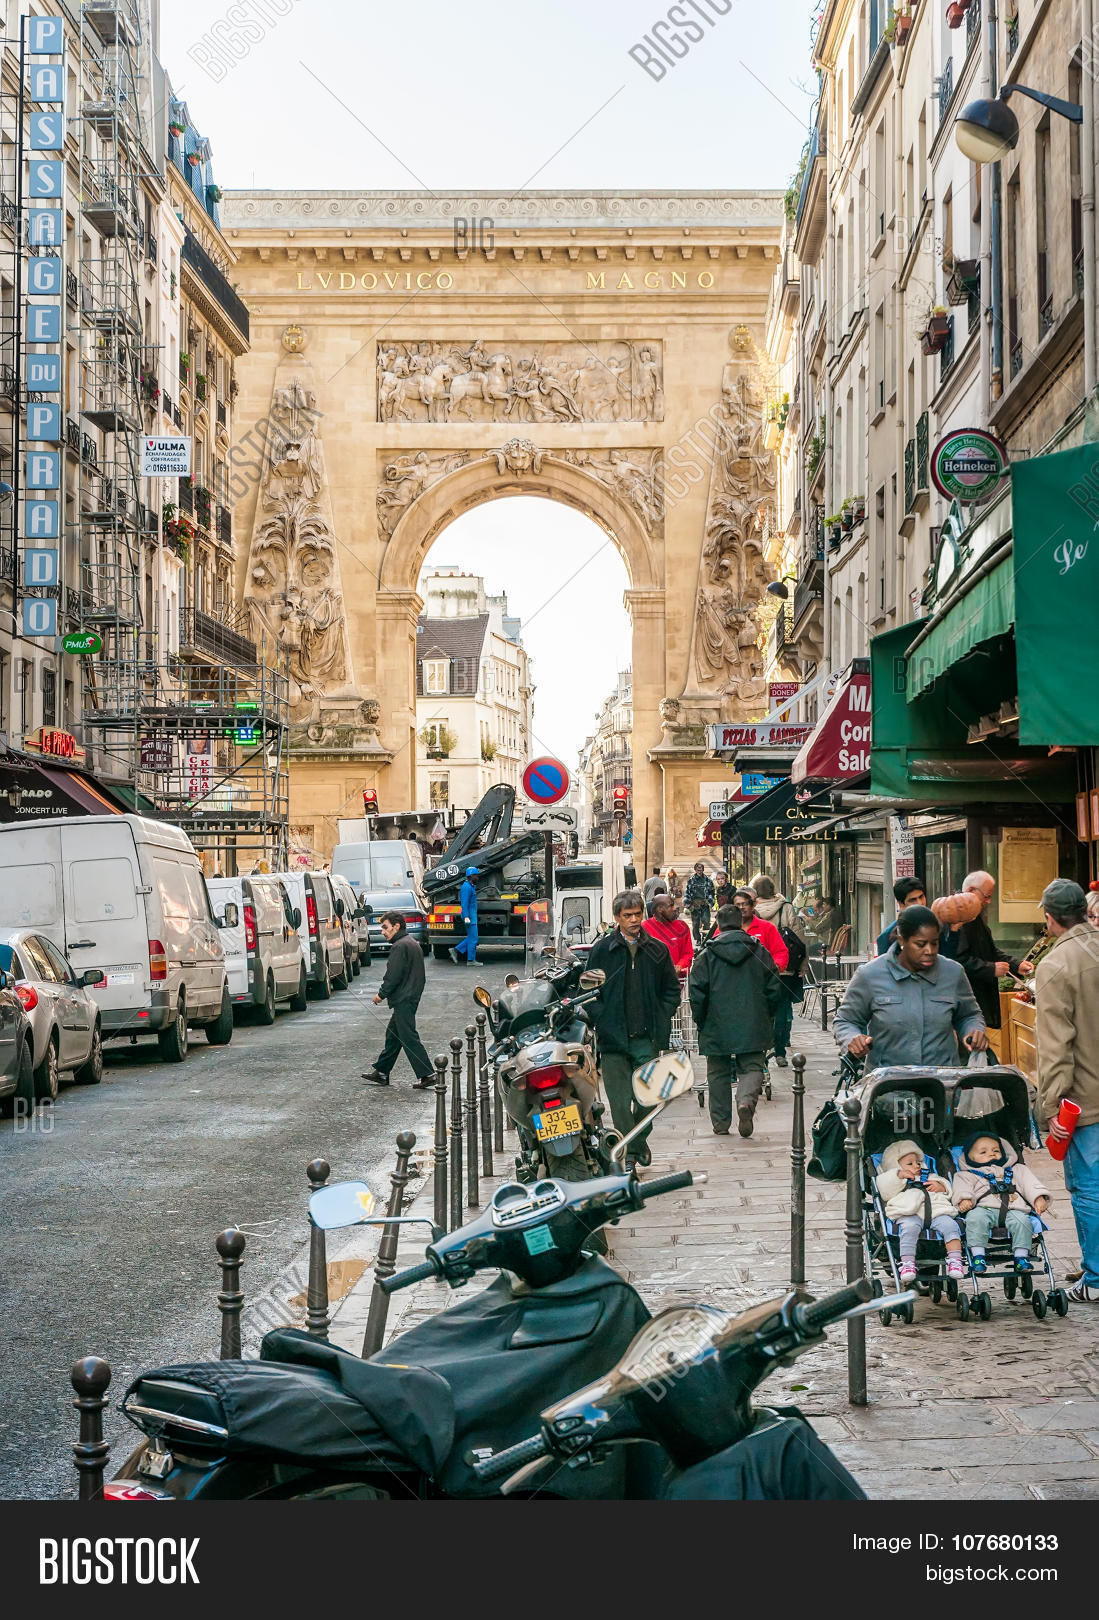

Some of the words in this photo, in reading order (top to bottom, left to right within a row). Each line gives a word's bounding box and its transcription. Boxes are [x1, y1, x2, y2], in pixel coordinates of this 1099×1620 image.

[33, 20, 57, 340] PASSAGE
[296, 270, 454, 292] LVDOVICO
[585, 270, 716, 289] MAGNO
[31, 363, 56, 383] DU
[157, 443, 186, 451] ULMA
[943, 461, 997, 472] Heineken
[29, 406, 53, 632] PRADO
[1053, 538, 1089, 576] Le
[722, 728, 757, 747] PIZZAS
[21, 789, 53, 798] RADO
[766, 826, 783, 841] LE
[449, 866, 458, 875] 90
[545, 1110, 567, 1124] 332
[538, 1124, 560, 1138] EHZ
[565, 1118, 580, 1131] 95
